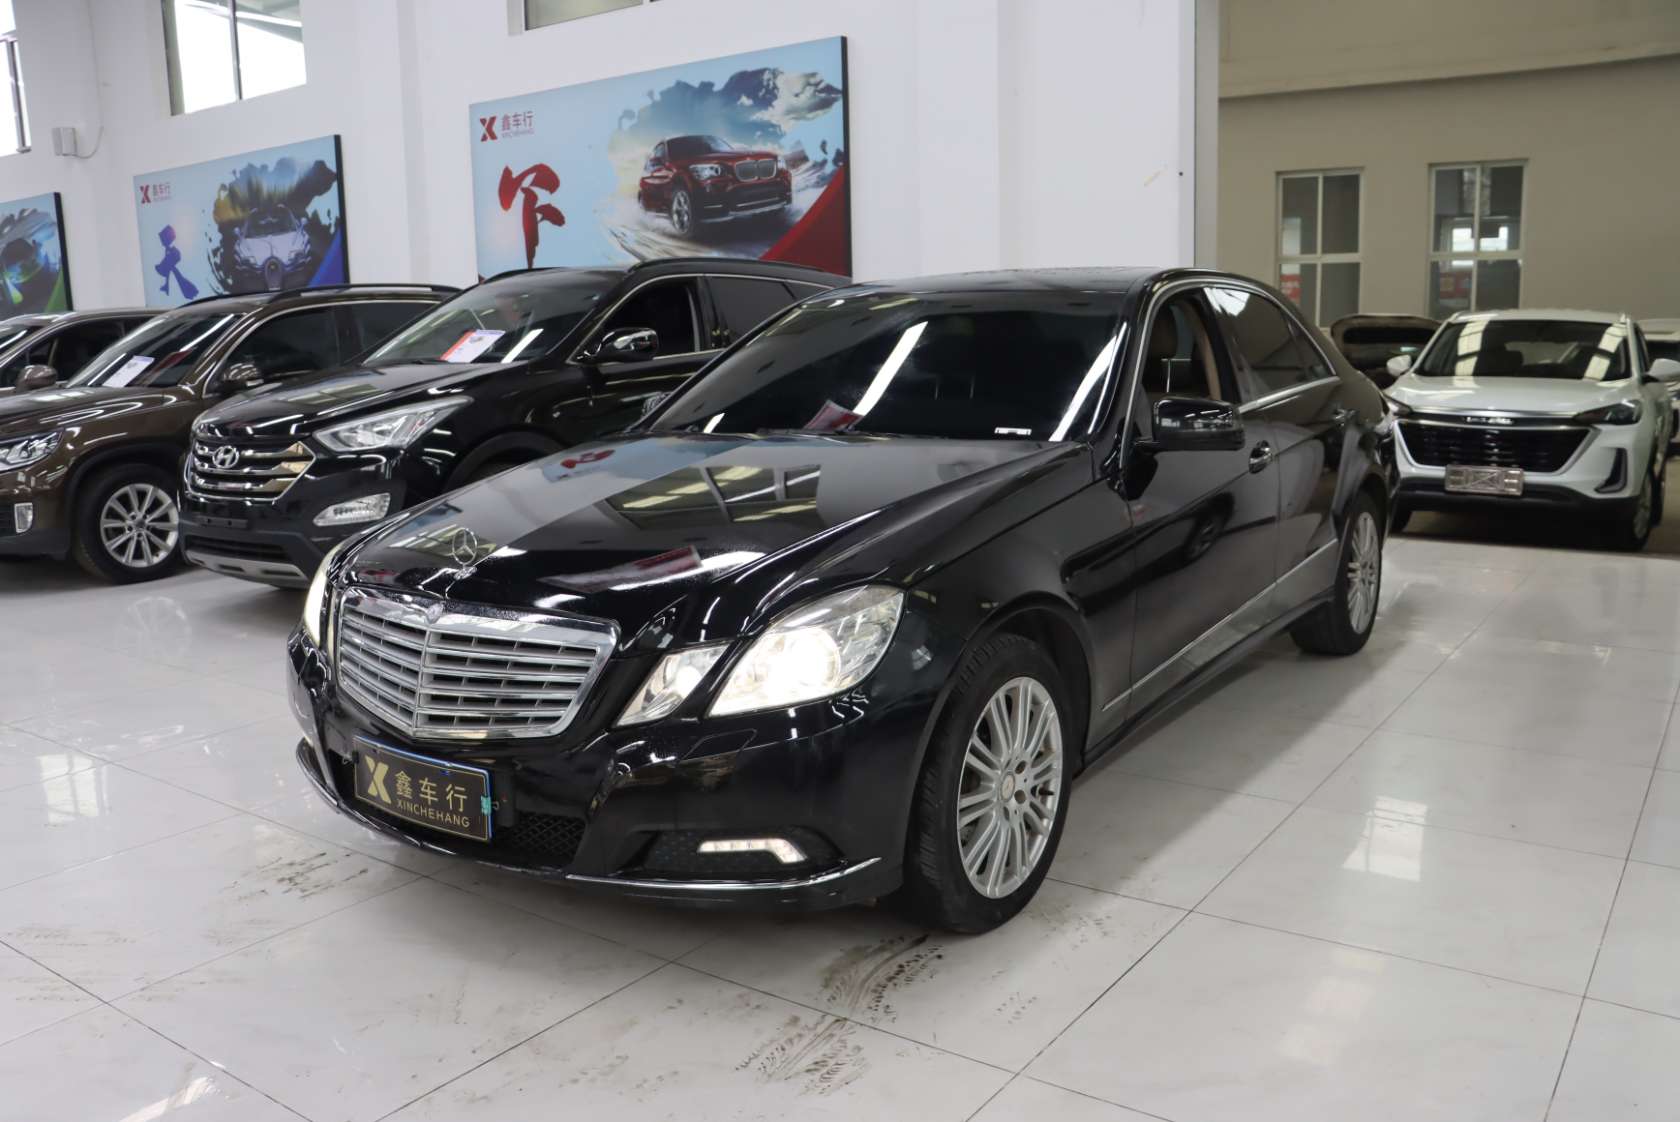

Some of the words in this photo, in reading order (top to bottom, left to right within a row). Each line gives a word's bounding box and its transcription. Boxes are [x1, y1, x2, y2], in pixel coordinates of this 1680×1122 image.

[395, 770, 468, 812] 鑫车行
[397, 799, 470, 828] XINCHEHANG
